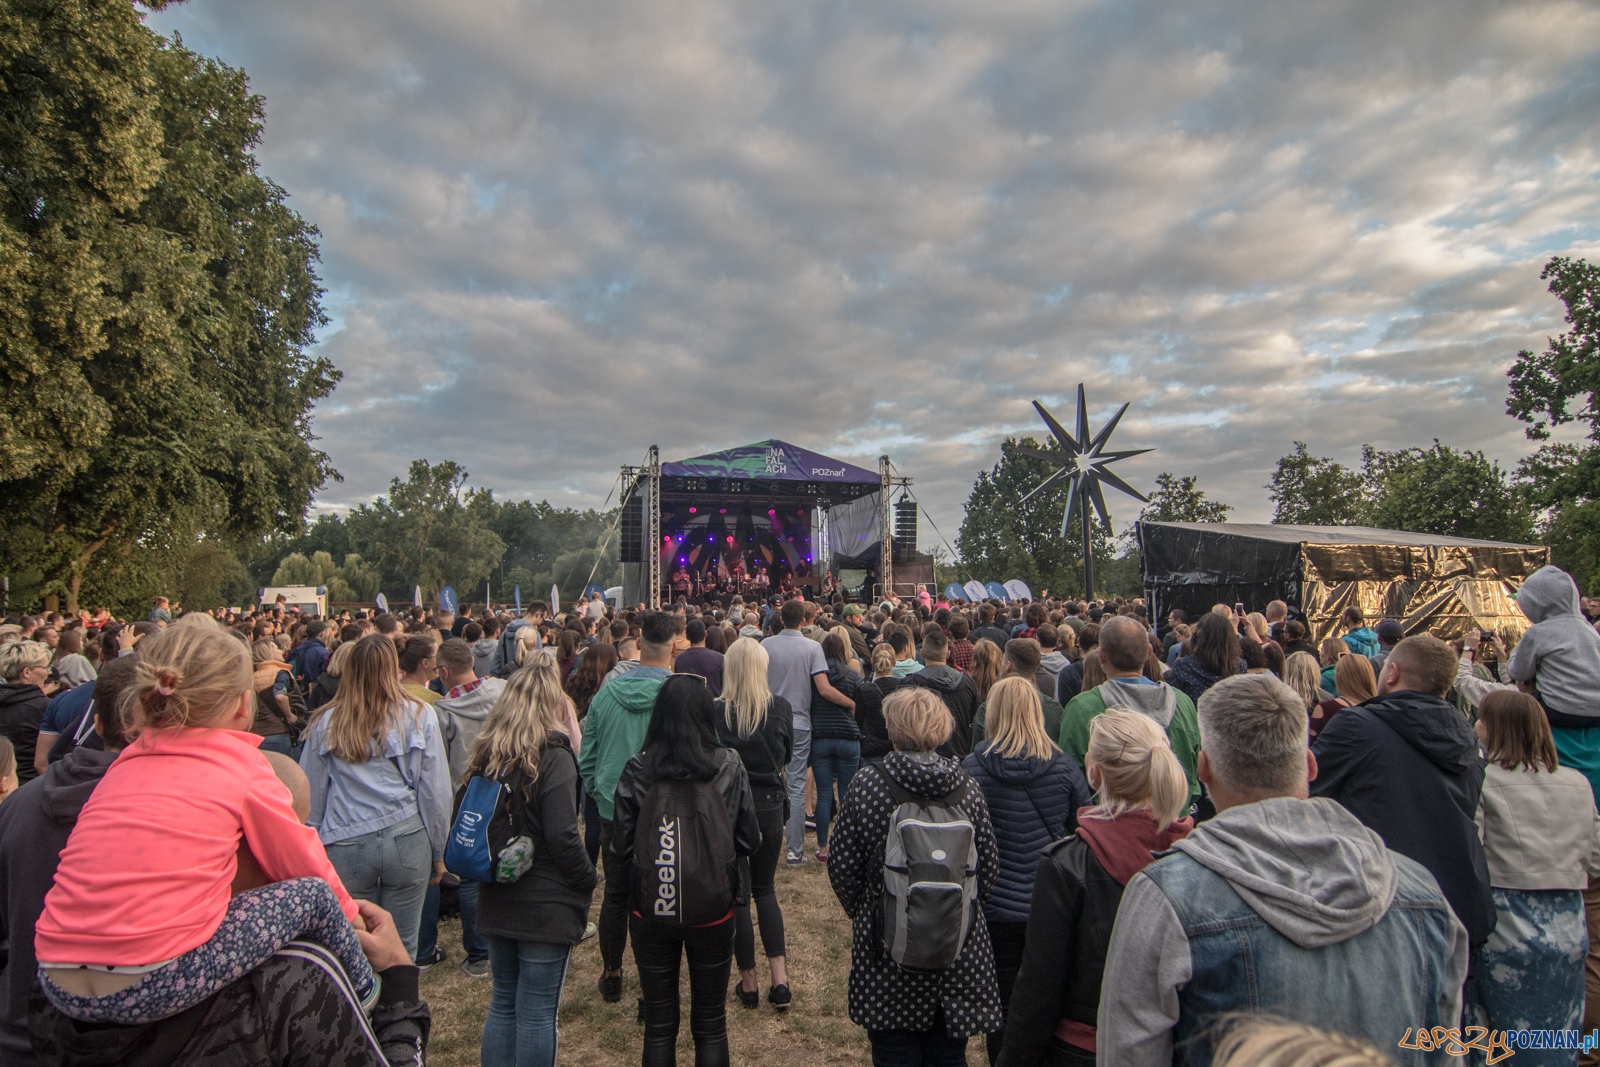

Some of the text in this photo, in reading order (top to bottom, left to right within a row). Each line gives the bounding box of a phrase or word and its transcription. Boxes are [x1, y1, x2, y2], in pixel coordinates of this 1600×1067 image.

[765, 456, 784, 465] FAL
[765, 464, 787, 474] ACH
[654, 815, 676, 916] Reebok
